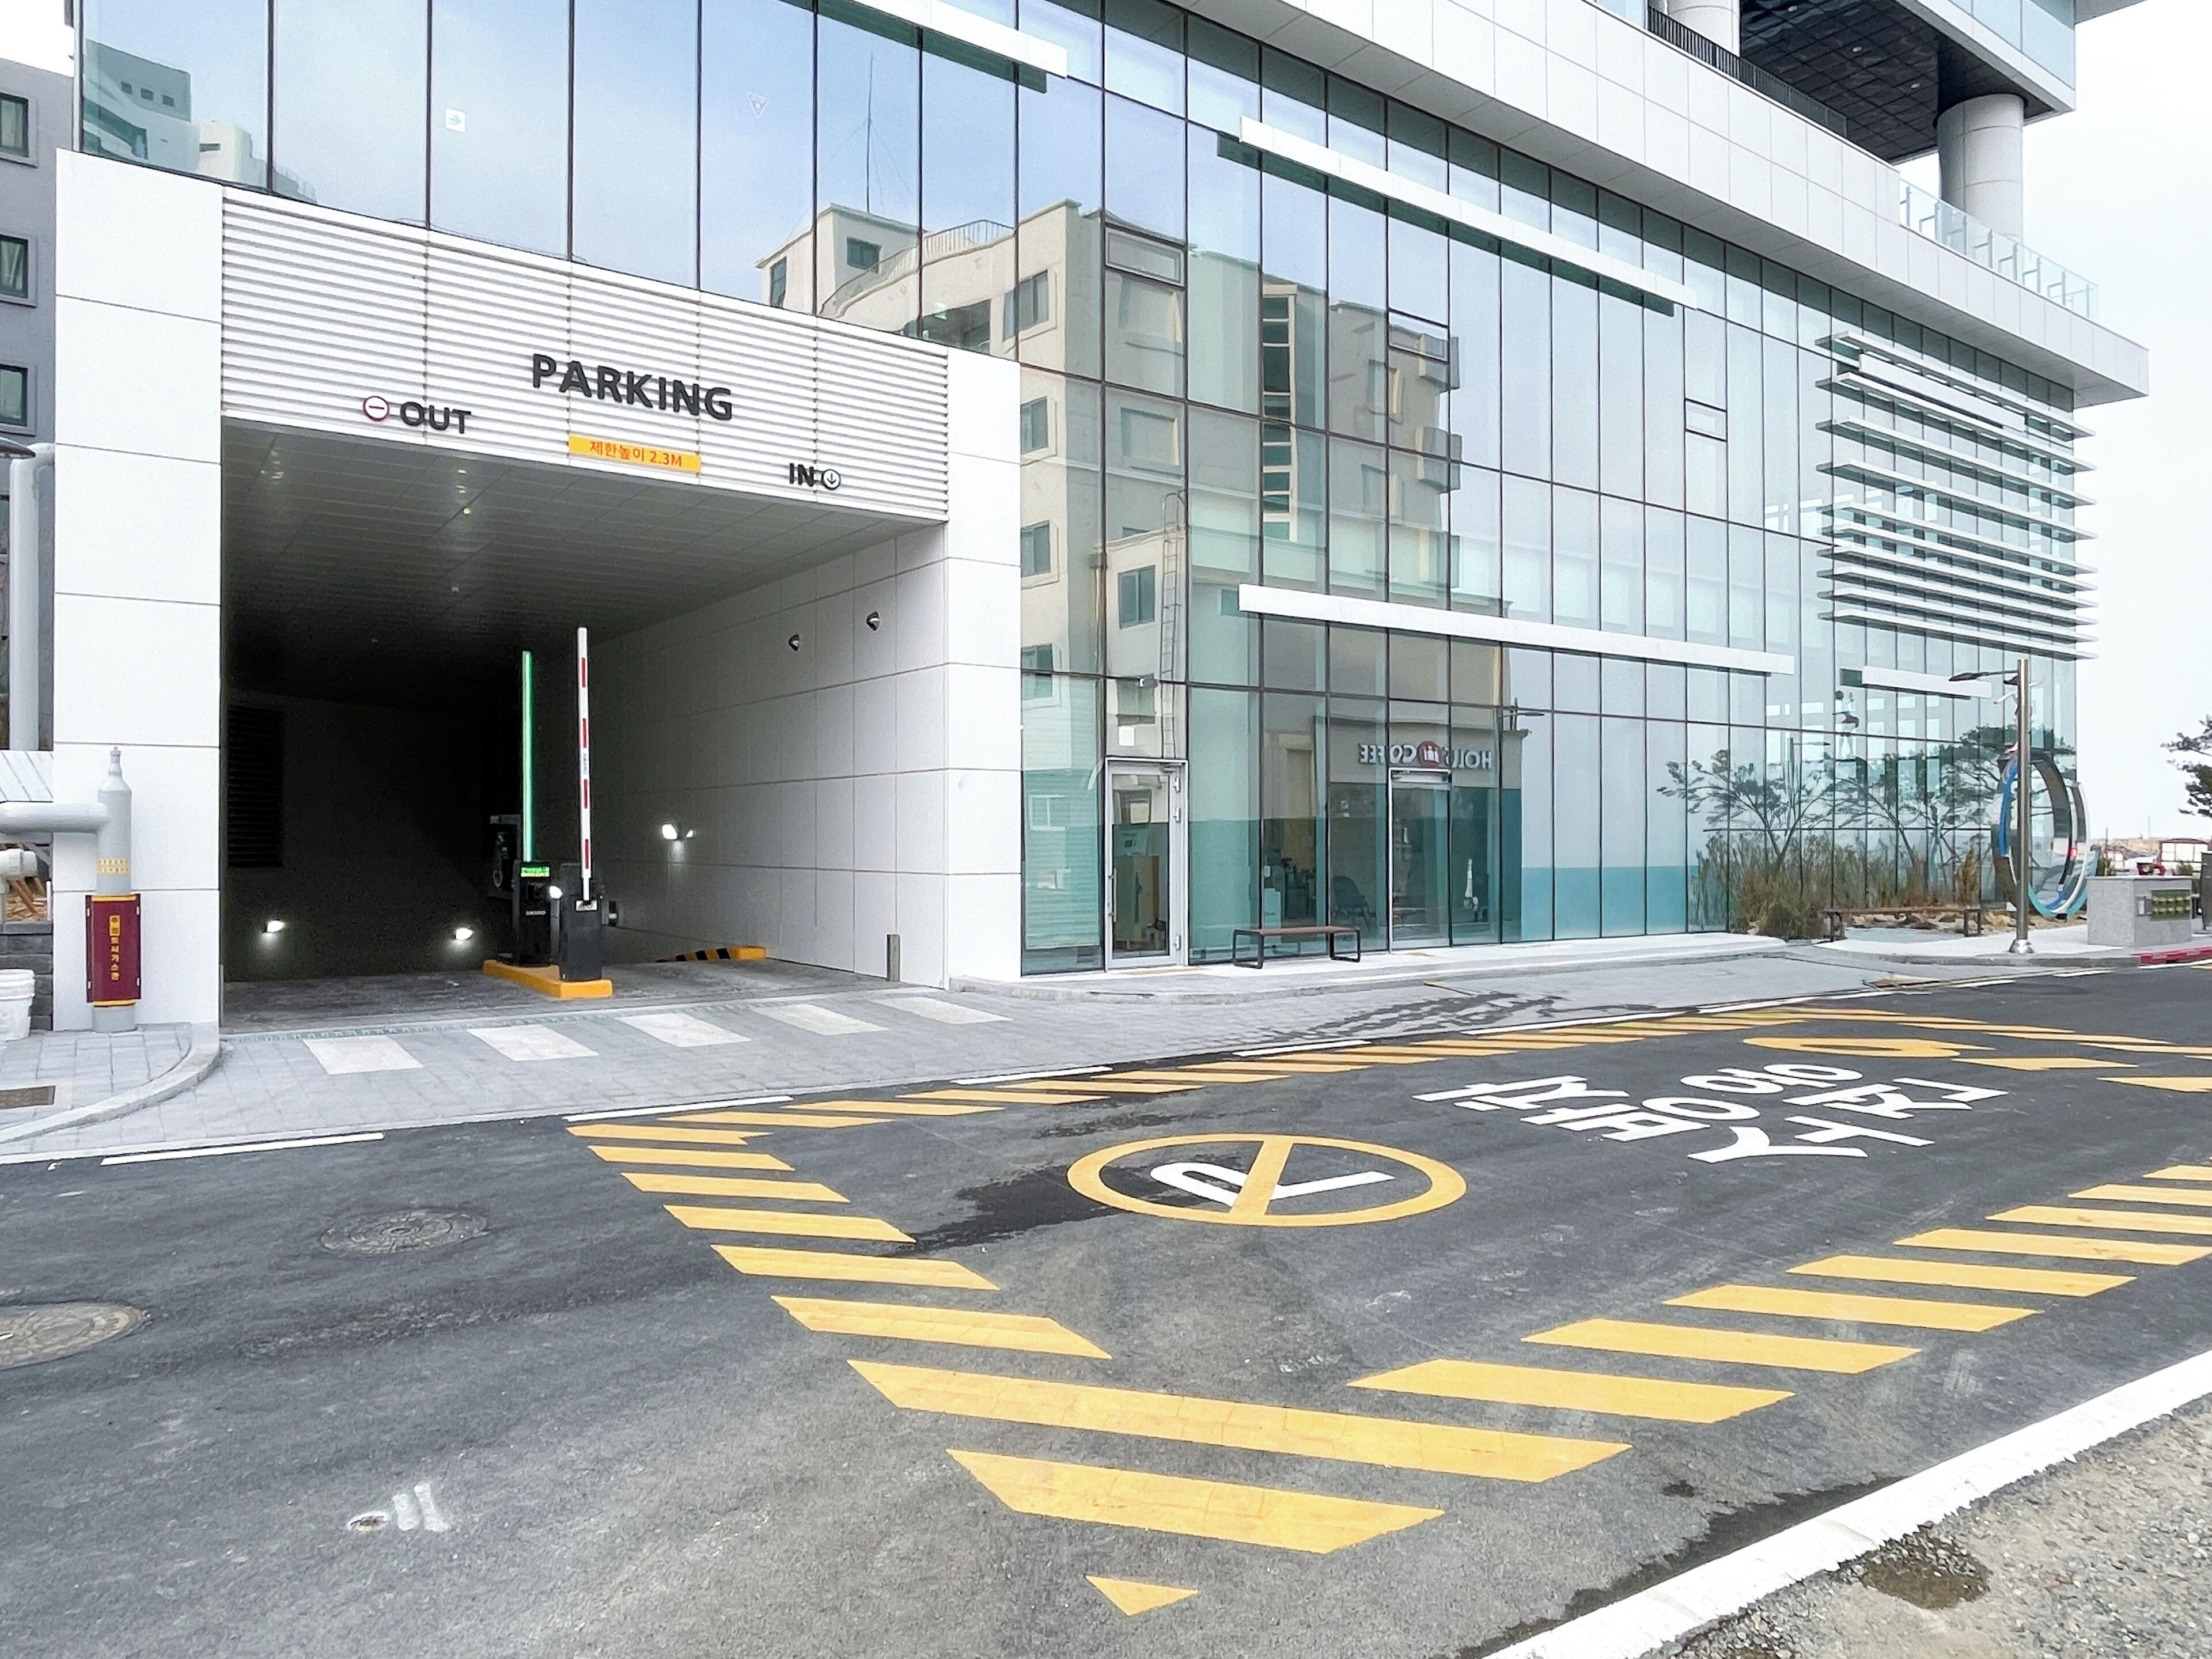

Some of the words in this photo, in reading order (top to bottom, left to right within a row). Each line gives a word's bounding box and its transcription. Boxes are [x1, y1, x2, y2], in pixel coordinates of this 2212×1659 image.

[532, 353, 733, 421] PARKING
[400, 401, 472, 434] OUT
[590, 441, 644, 461] 제한높이
[649, 451, 682, 467] 2.3M
[789, 462, 815, 487] IN
[1679, 1064, 2009, 1119] 전용
[1411, 1075, 1936, 1163] 소방차
